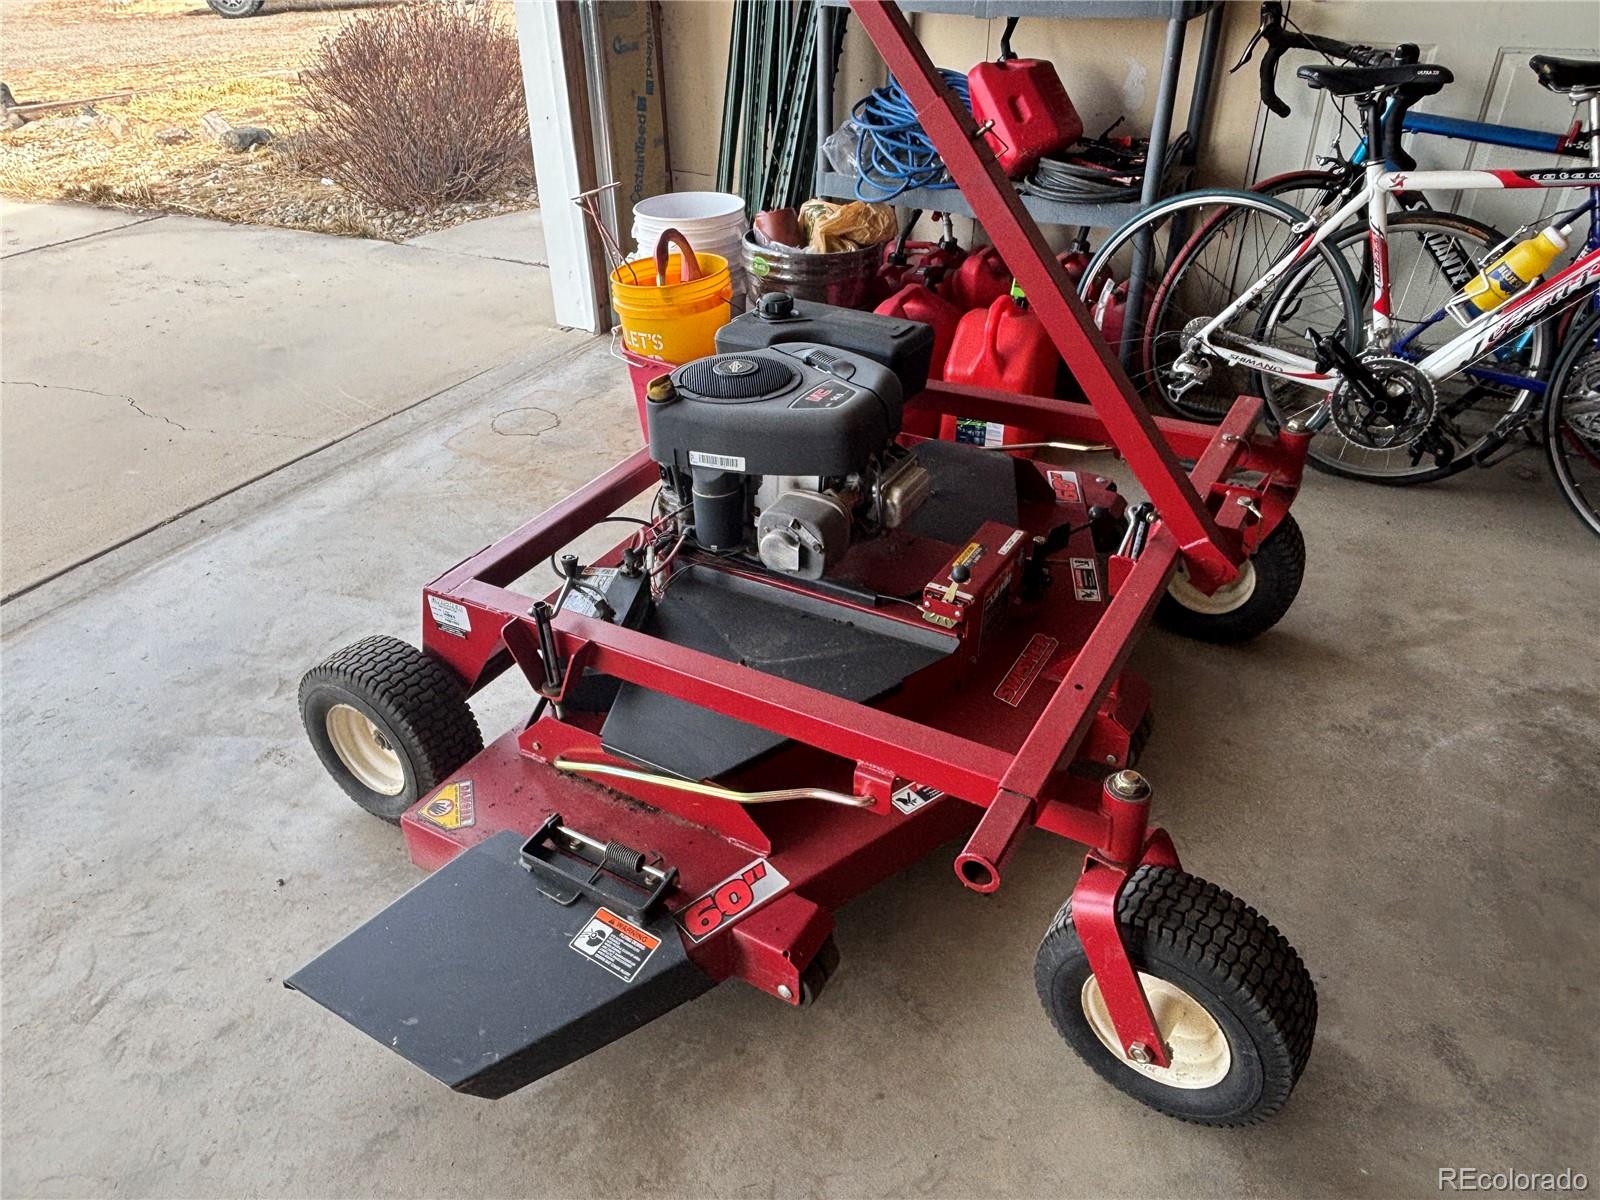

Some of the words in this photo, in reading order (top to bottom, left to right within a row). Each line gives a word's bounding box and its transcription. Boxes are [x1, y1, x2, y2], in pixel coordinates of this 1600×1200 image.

[624, 330, 664, 351] LET'S
[1229, 353, 1284, 373] SHIMANO
[684, 860, 767, 935] 60"
[616, 923, 648, 942] WARNING
